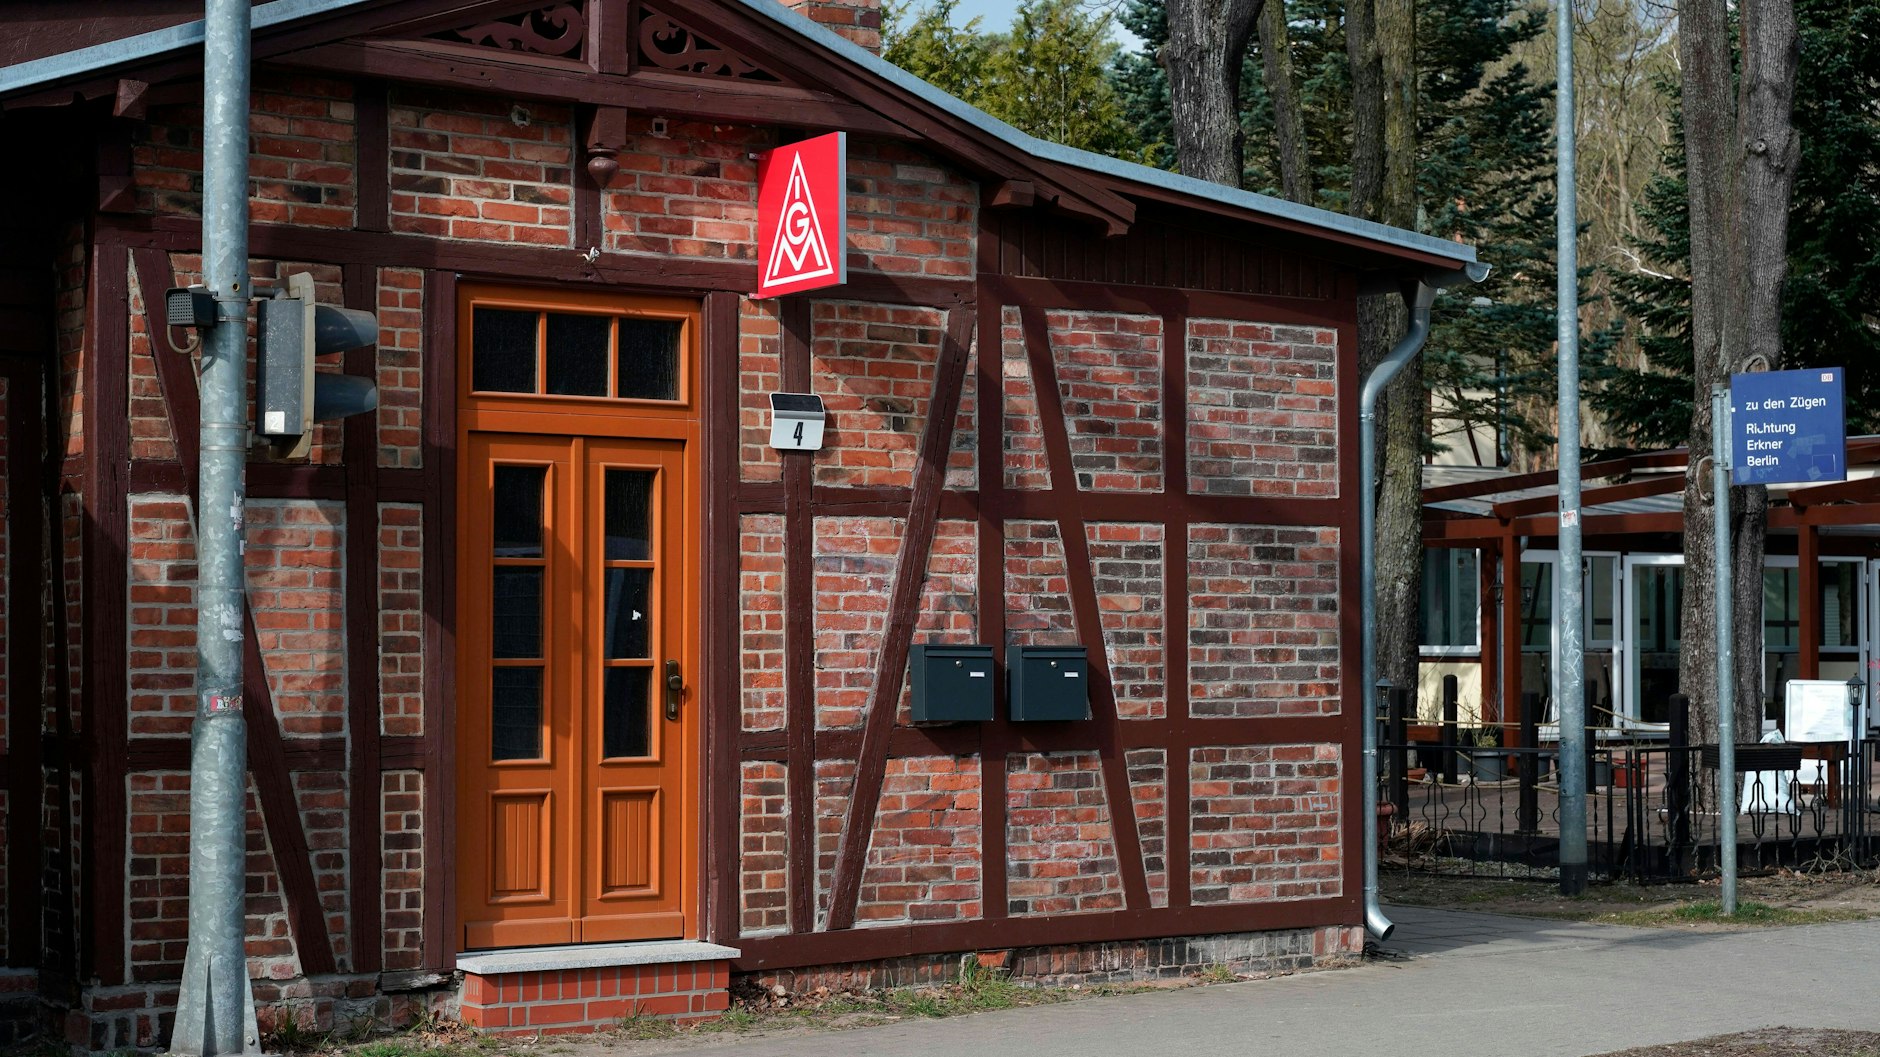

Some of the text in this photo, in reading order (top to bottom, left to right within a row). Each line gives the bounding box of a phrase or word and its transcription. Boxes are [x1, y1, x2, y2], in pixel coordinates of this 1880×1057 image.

[1746, 396, 1826, 411] zu den Zügen
[270, 415, 279, 430] 2
[793, 422, 804, 446] 4
[1746, 440, 1783, 451] Erkner
[1747, 455, 1779, 467] Berlin
